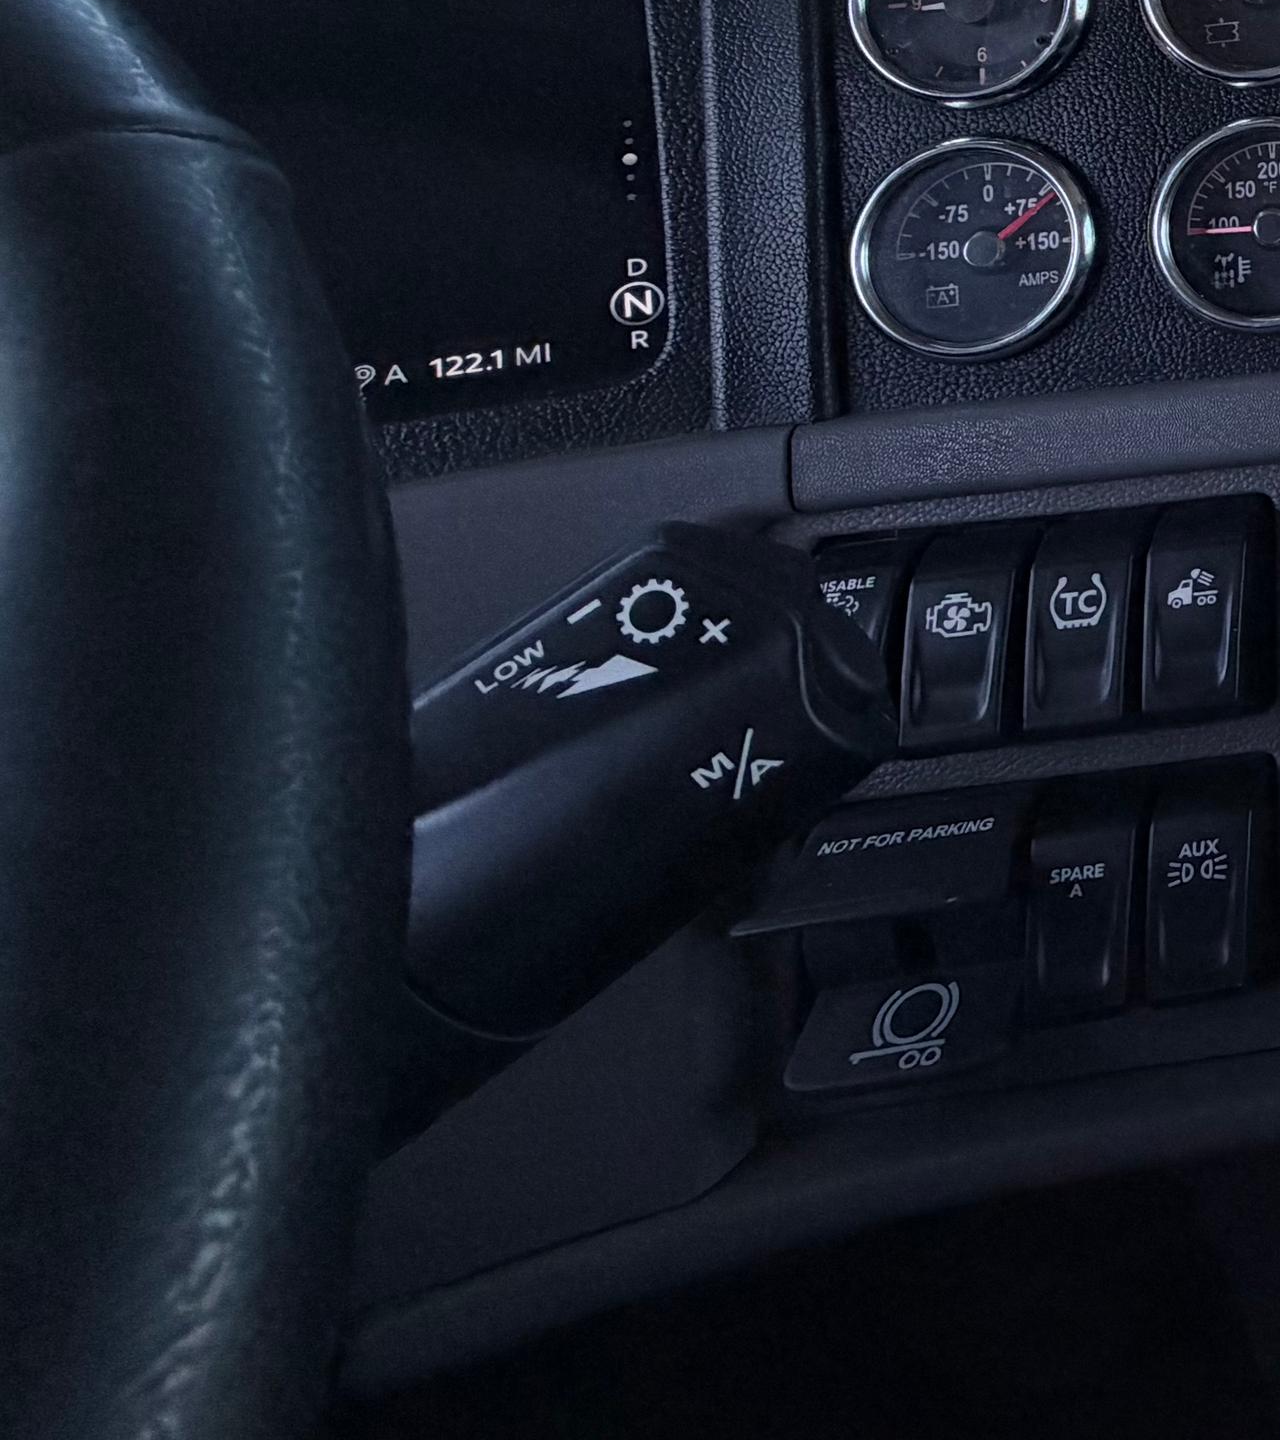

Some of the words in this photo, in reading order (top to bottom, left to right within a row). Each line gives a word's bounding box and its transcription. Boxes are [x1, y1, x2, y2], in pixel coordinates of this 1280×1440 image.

[977, 47, 988, 62] 6
[982, 185, 994, 201] 0
[1224, 180, 1256, 199] 150
[939, 205, 969, 223] -75
[918, 241, 960, 260] -150
[1015, 231, 1060, 251] +150
[626, 258, 648, 277] D
[1018, 270, 1059, 287] AMPS
[622, 289, 653, 320] N
[630, 330, 649, 350] R
[384, 364, 408, 386] A
[429, 349, 504, 379] 122.1
[515, 342, 552, 367] MI
[1060, 590, 1098, 616] TC
[474, 640, 546, 695] LOW
[690, 727, 784, 800] M/A
[817, 836, 861, 857] NOT
[862, 831, 905, 850] FOR
[907, 817, 995, 842] PARKING
[1178, 838, 1221, 859] AUX
[1049, 862, 1105, 885] SPARE
[1068, 883, 1084, 898] A
